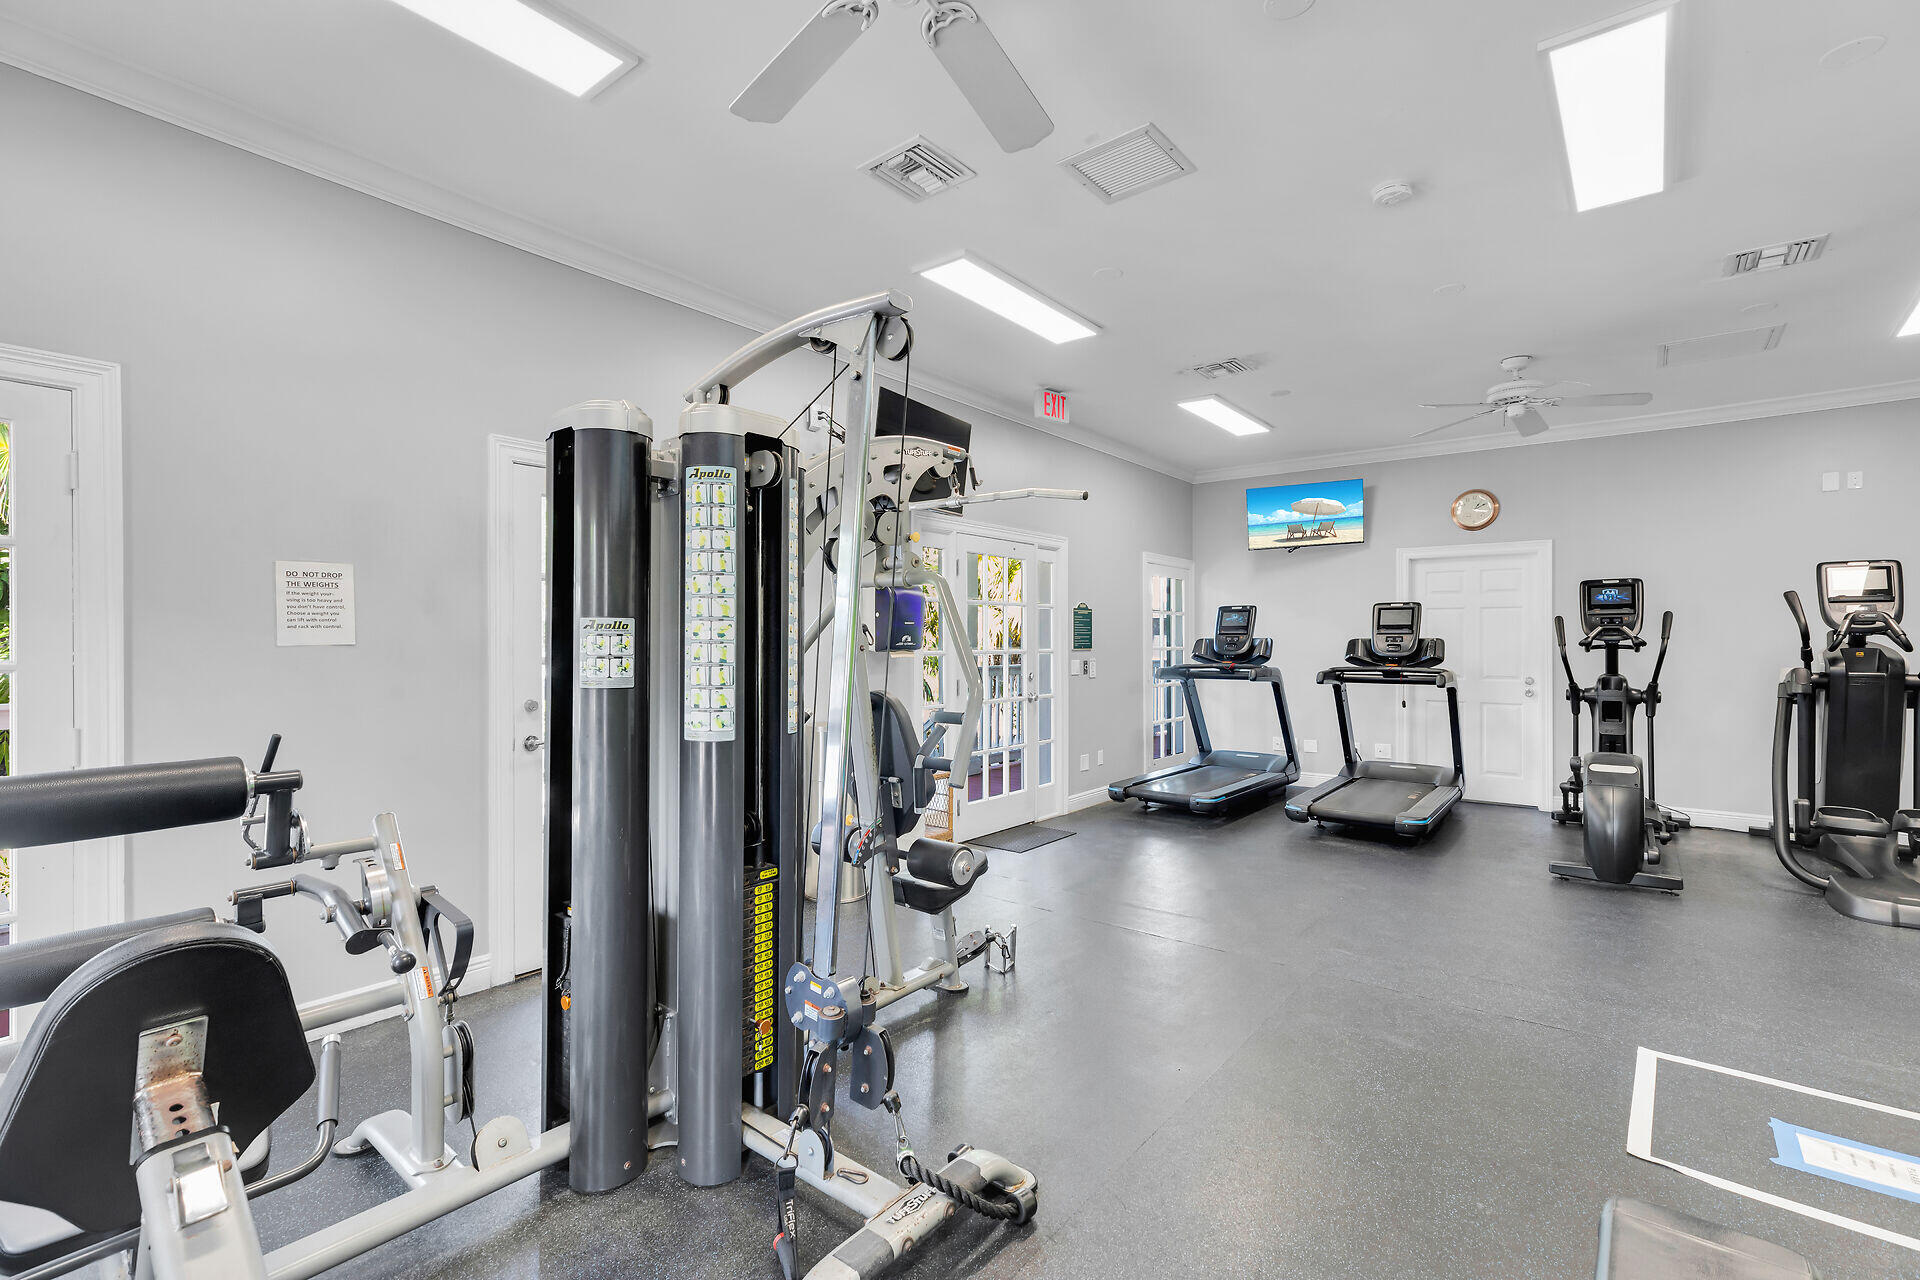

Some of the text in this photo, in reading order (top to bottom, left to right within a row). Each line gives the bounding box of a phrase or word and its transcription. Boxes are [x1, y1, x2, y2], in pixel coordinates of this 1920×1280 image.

[1043, 391, 1066, 420] EXIT
[688, 468, 731, 480] Apollo
[285, 570, 298, 578] DO
[302, 571, 319, 579] NOT
[583, 620, 630, 631] Apollo
